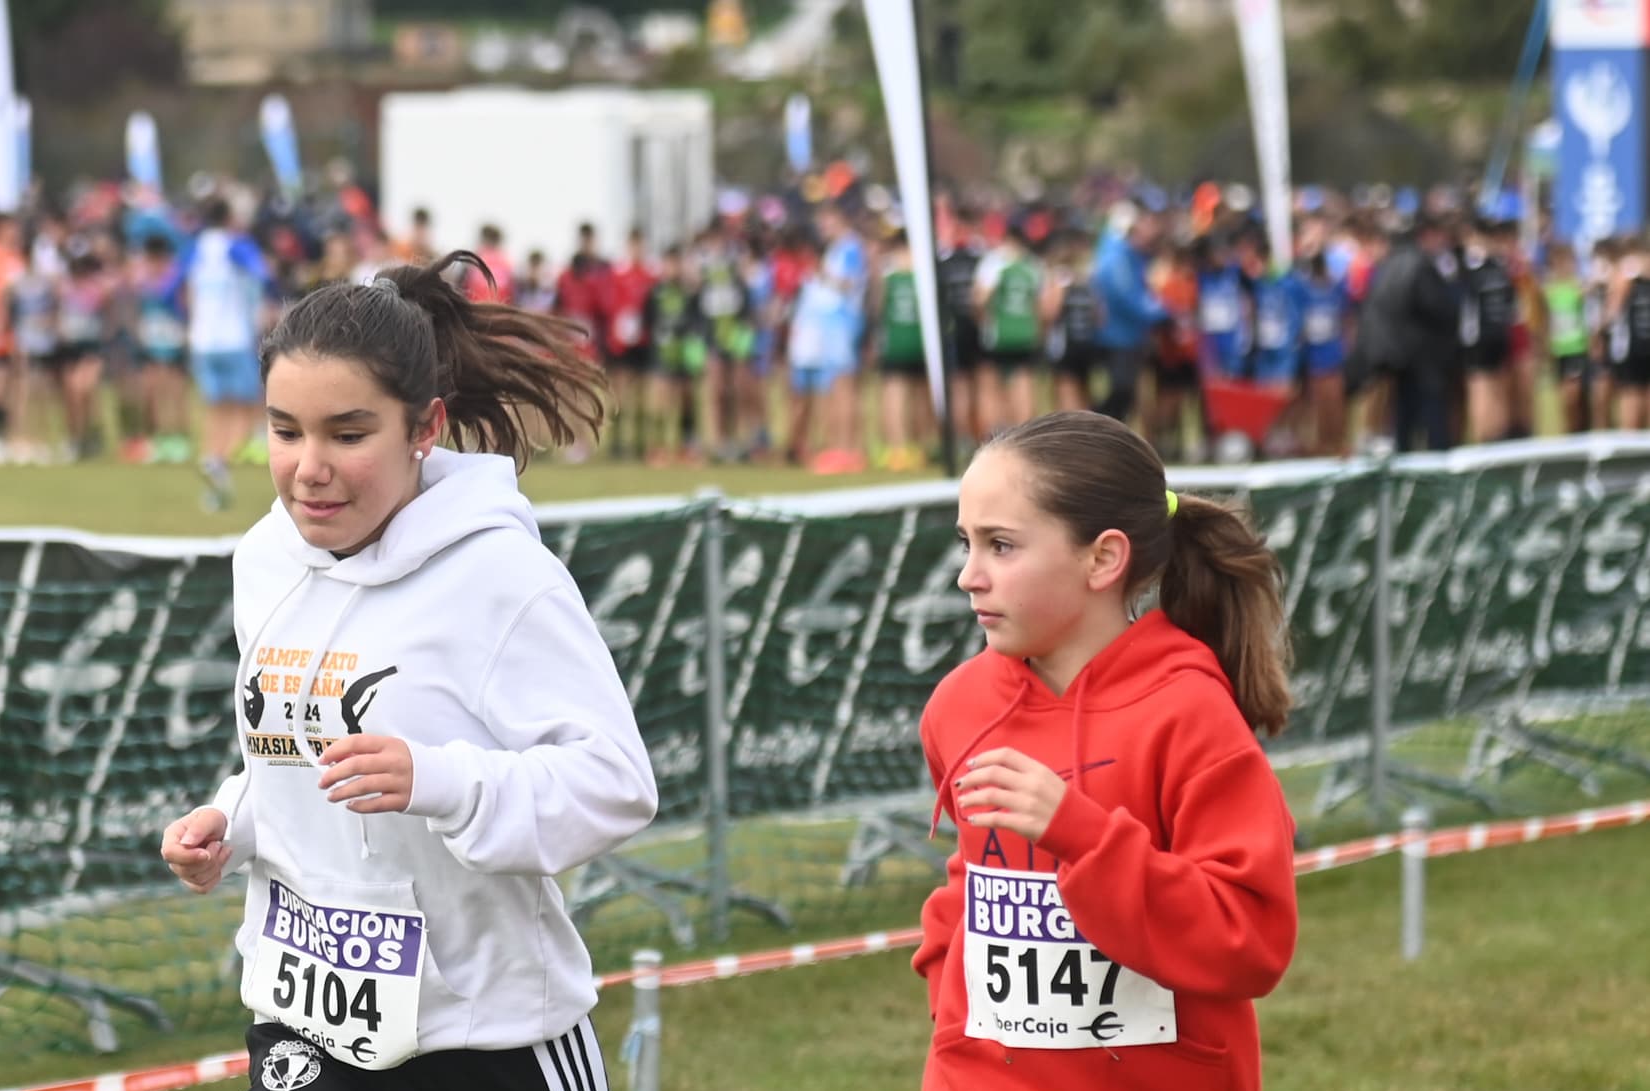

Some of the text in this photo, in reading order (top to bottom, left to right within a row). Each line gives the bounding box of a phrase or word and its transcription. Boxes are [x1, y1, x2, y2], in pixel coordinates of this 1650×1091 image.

[256, 647, 359, 671] CAMPENATO
[260, 671, 344, 698] DE ESAÑA
[284, 701, 321, 722] 224
[973, 874, 1065, 907] DIPUTA
[277, 884, 406, 940] DIPUTACIÓN
[974, 899, 1076, 940] BURG
[272, 907, 404, 972] BURGOS
[272, 951, 382, 1033] 5104
[986, 943, 1123, 1007] 5147
[992, 1012, 1069, 1039] berCaja
